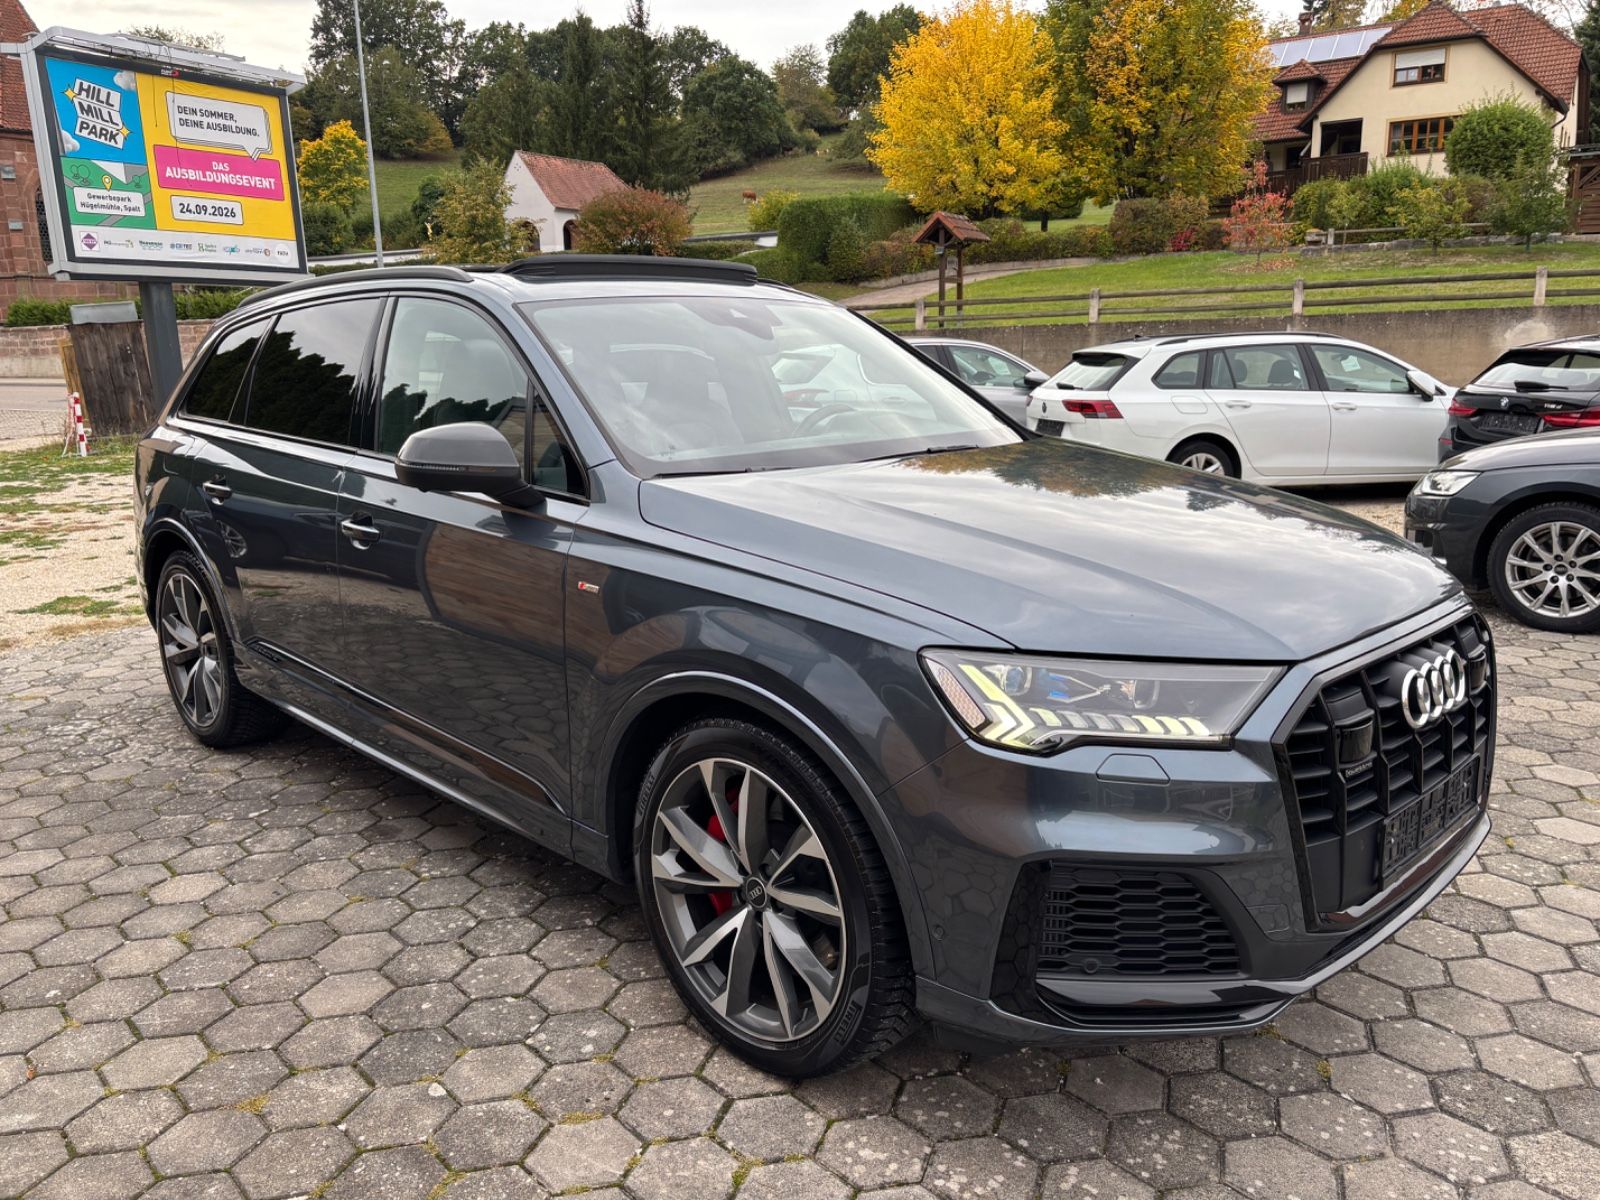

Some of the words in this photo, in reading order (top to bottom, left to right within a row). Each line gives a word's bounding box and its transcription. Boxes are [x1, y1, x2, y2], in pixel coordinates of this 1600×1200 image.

[78, 81, 115, 107] HILL
[78, 101, 120, 127] MILL
[177, 105, 197, 116] DEIN
[199, 108, 238, 123] SOMMER,
[79, 122, 120, 146] PARK
[179, 117, 204, 130] DEINE
[206, 124, 260, 137] AUSBILDUNG.
[212, 161, 230, 171] DAS
[165, 166, 276, 190] AUSBILDUNGSEVENT
[87, 192, 132, 204] Gewerbepark
[123, 204, 141, 213] Spalt
[179, 202, 236, 218] 24.09.2026
[834, 999, 863, 1045] PIRELLI
